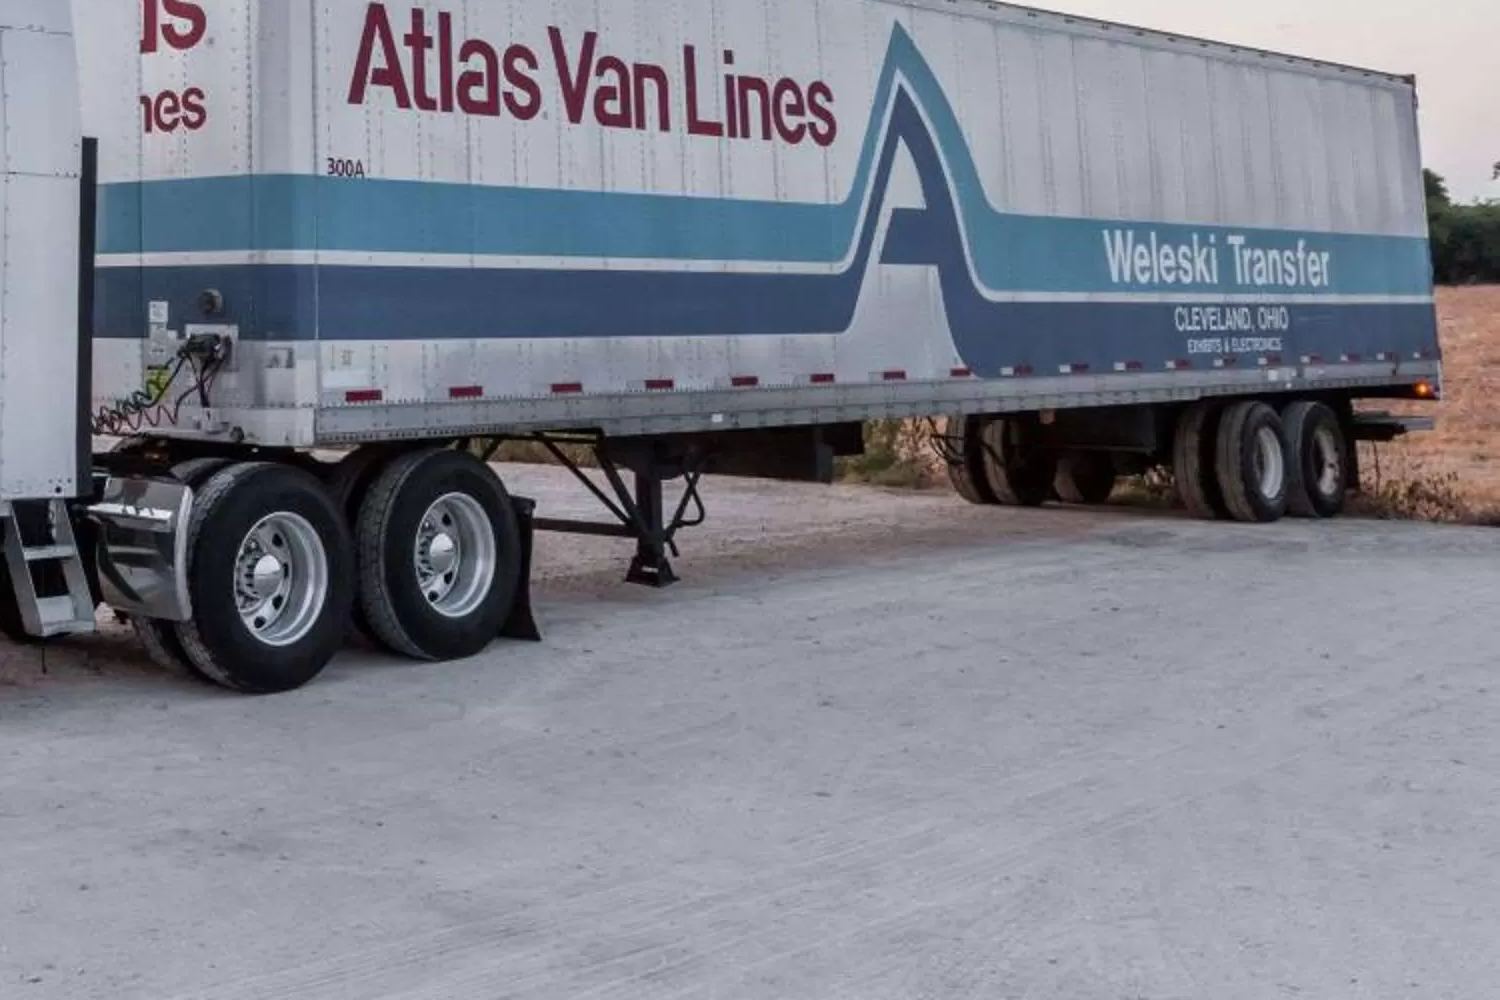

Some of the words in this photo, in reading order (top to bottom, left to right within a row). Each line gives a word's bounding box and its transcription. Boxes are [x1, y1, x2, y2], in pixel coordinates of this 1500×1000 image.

[347, 1, 543, 121] Atlas
[547, 25, 671, 132] Van
[683, 44, 838, 147] Lines
[327, 157, 365, 180] 300A
[1102, 228, 1219, 285] Weleski
[1227, 235, 1330, 287] Transfer
[1174, 304, 1256, 333] CLEVELAND,
[1257, 304, 1290, 331] OHIO
